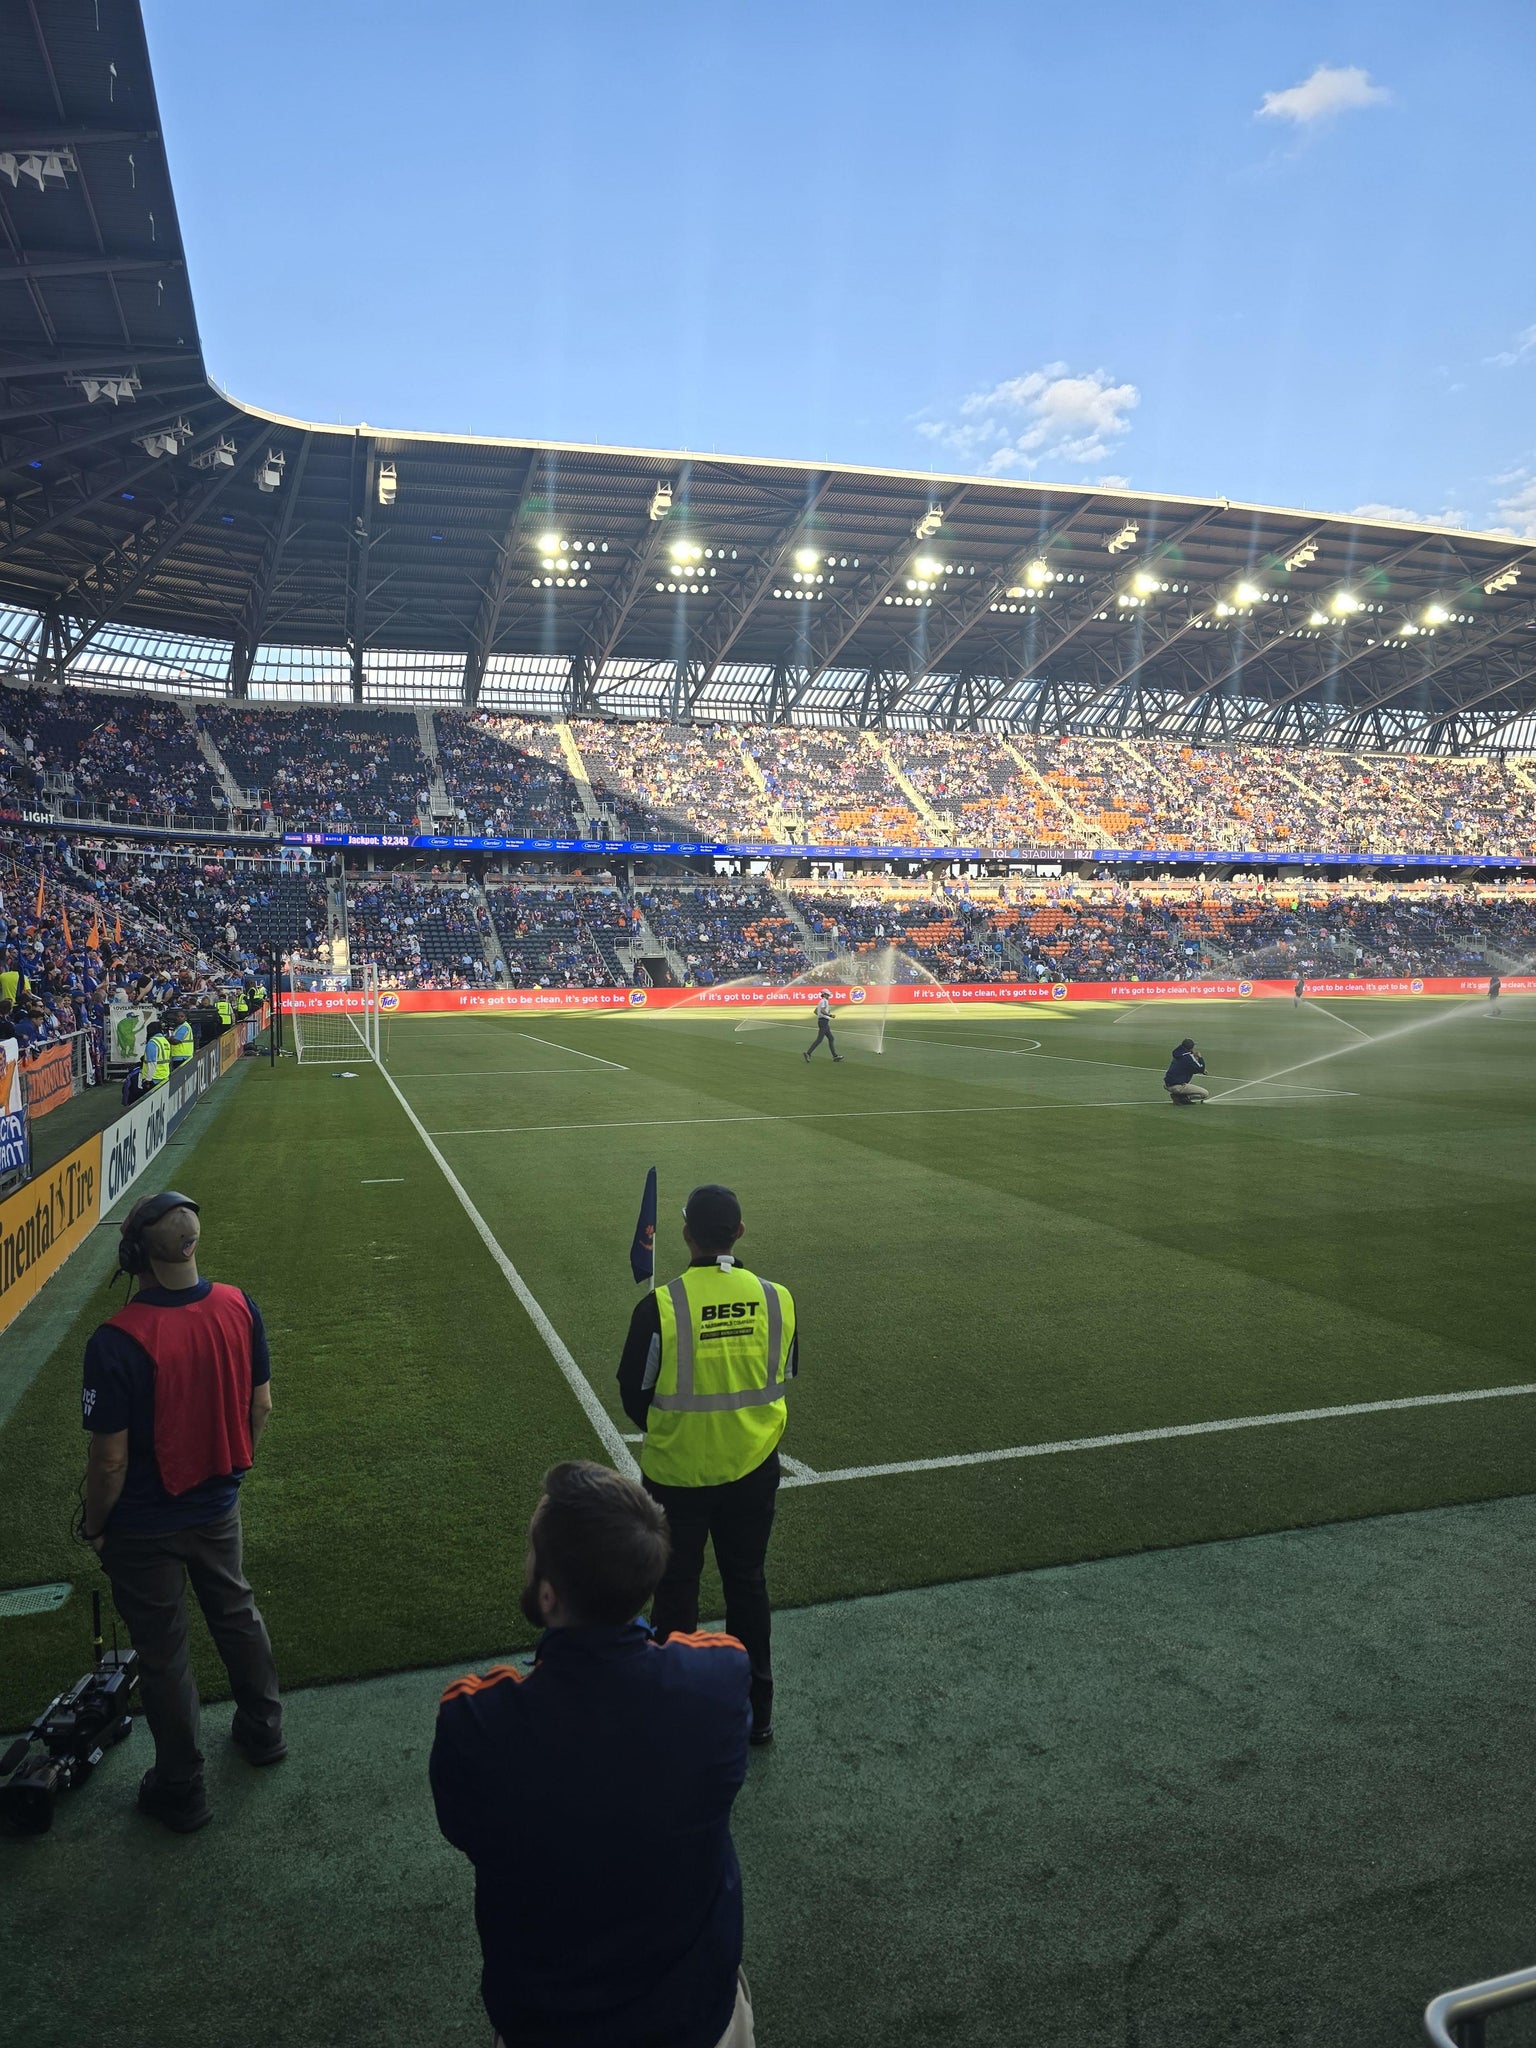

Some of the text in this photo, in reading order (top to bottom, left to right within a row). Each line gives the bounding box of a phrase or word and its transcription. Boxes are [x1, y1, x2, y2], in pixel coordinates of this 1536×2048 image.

[23, 811, 54, 824] LIGHT
[348, 836, 408, 846] Jackpot: $2,343
[992, 850, 1065, 858] TQL STADIUM
[1074, 850, 1093, 858] 18:27
[936, 989, 950, 998] got
[1013, 989, 1026, 997] got
[309, 998, 322, 1006] it's
[326, 999, 344, 1007] got
[381, 997, 397, 1007] Tide
[460, 996, 467, 1004] If
[488, 997, 504, 1005] got
[507, 996, 518, 1004] to
[520, 996, 533, 1004] be
[535, 995, 562, 1004] clean,
[582, 996, 598, 1004] got
[630, 994, 645, 1003] Tide
[0, 1115, 22, 1142] CTA
[0, 1140, 24, 1170] ANT
[66, 1160, 93, 1228] Tire
[702, 1302, 760, 1321] BEST
